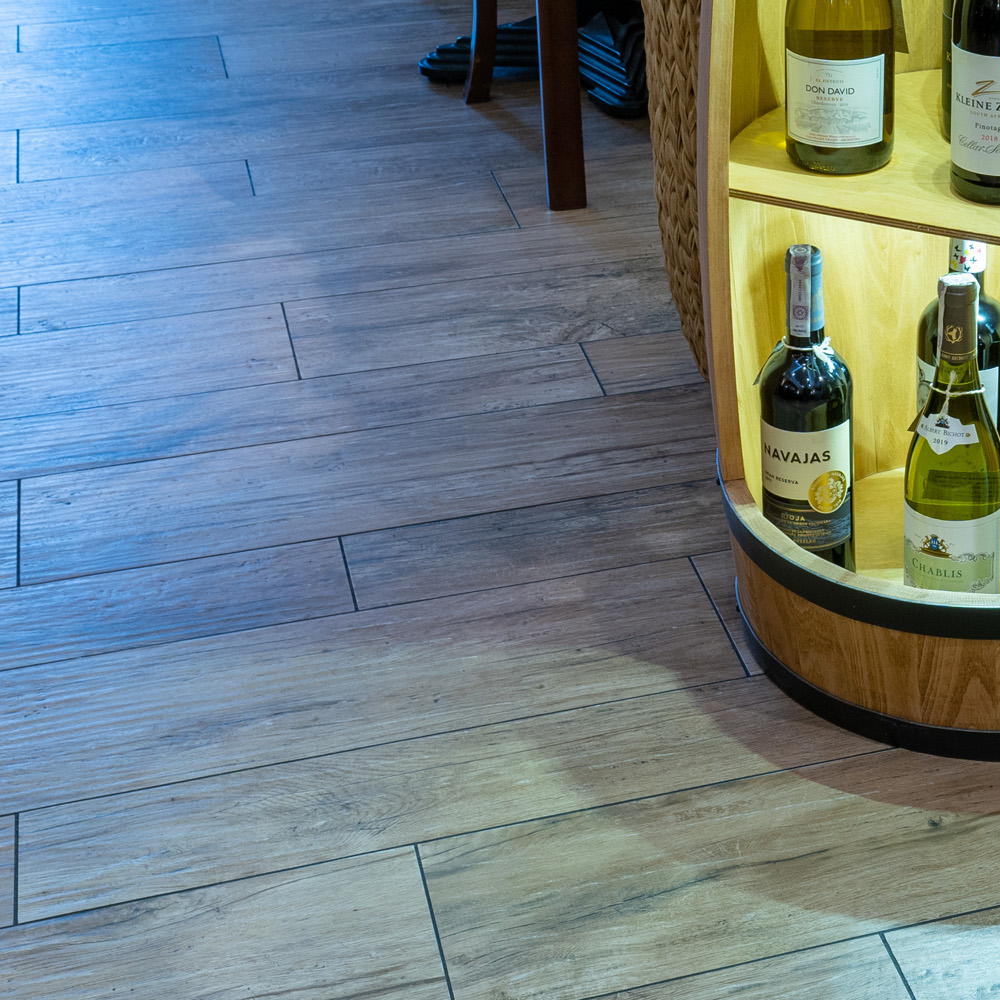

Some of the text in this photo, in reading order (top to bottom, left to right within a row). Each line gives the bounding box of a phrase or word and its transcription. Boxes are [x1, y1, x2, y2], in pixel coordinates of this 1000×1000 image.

[806, 84, 855, 95] DON DAVID
[956, 92, 992, 111] KLEINE
[970, 110, 988, 118] SOUTH
[924, 424, 965, 438] ALBERT BICHOT
[933, 437, 948, 445] 2019
[764, 442, 831, 464] NAVAJAS
[776, 476, 799, 485] RESERVA
[911, 557, 963, 578] CHABLIS
